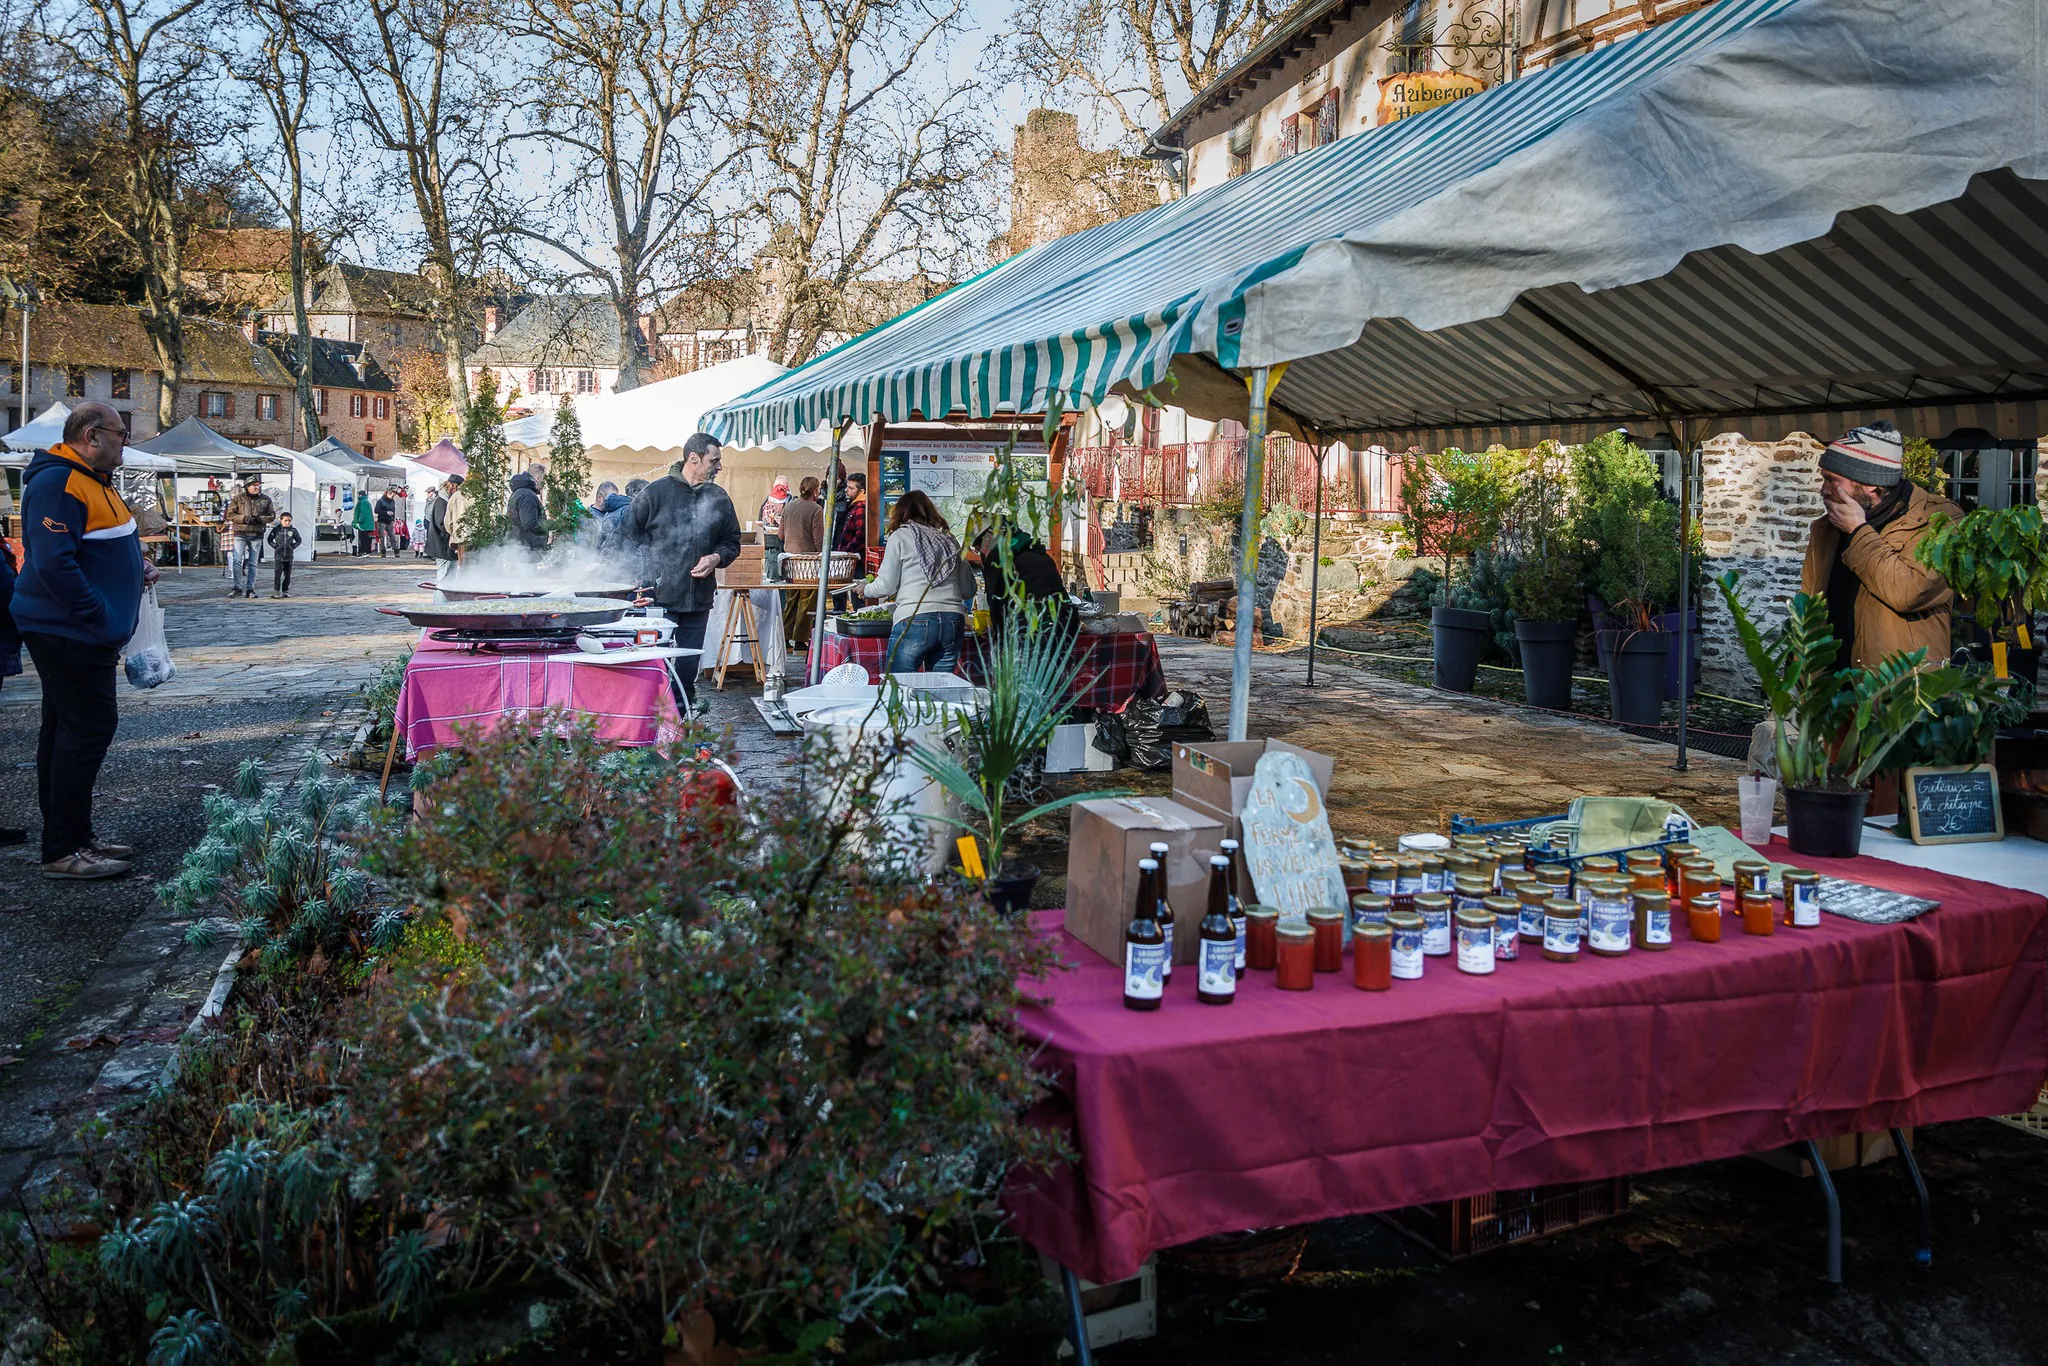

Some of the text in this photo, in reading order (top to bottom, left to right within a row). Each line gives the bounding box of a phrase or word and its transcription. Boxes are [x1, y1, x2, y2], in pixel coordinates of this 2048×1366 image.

[1255, 788, 1277, 809] LA
[1919, 796, 1934, 812] la
[1937, 813, 1963, 834] 2€
[1272, 875, 1328, 917] LUNE
